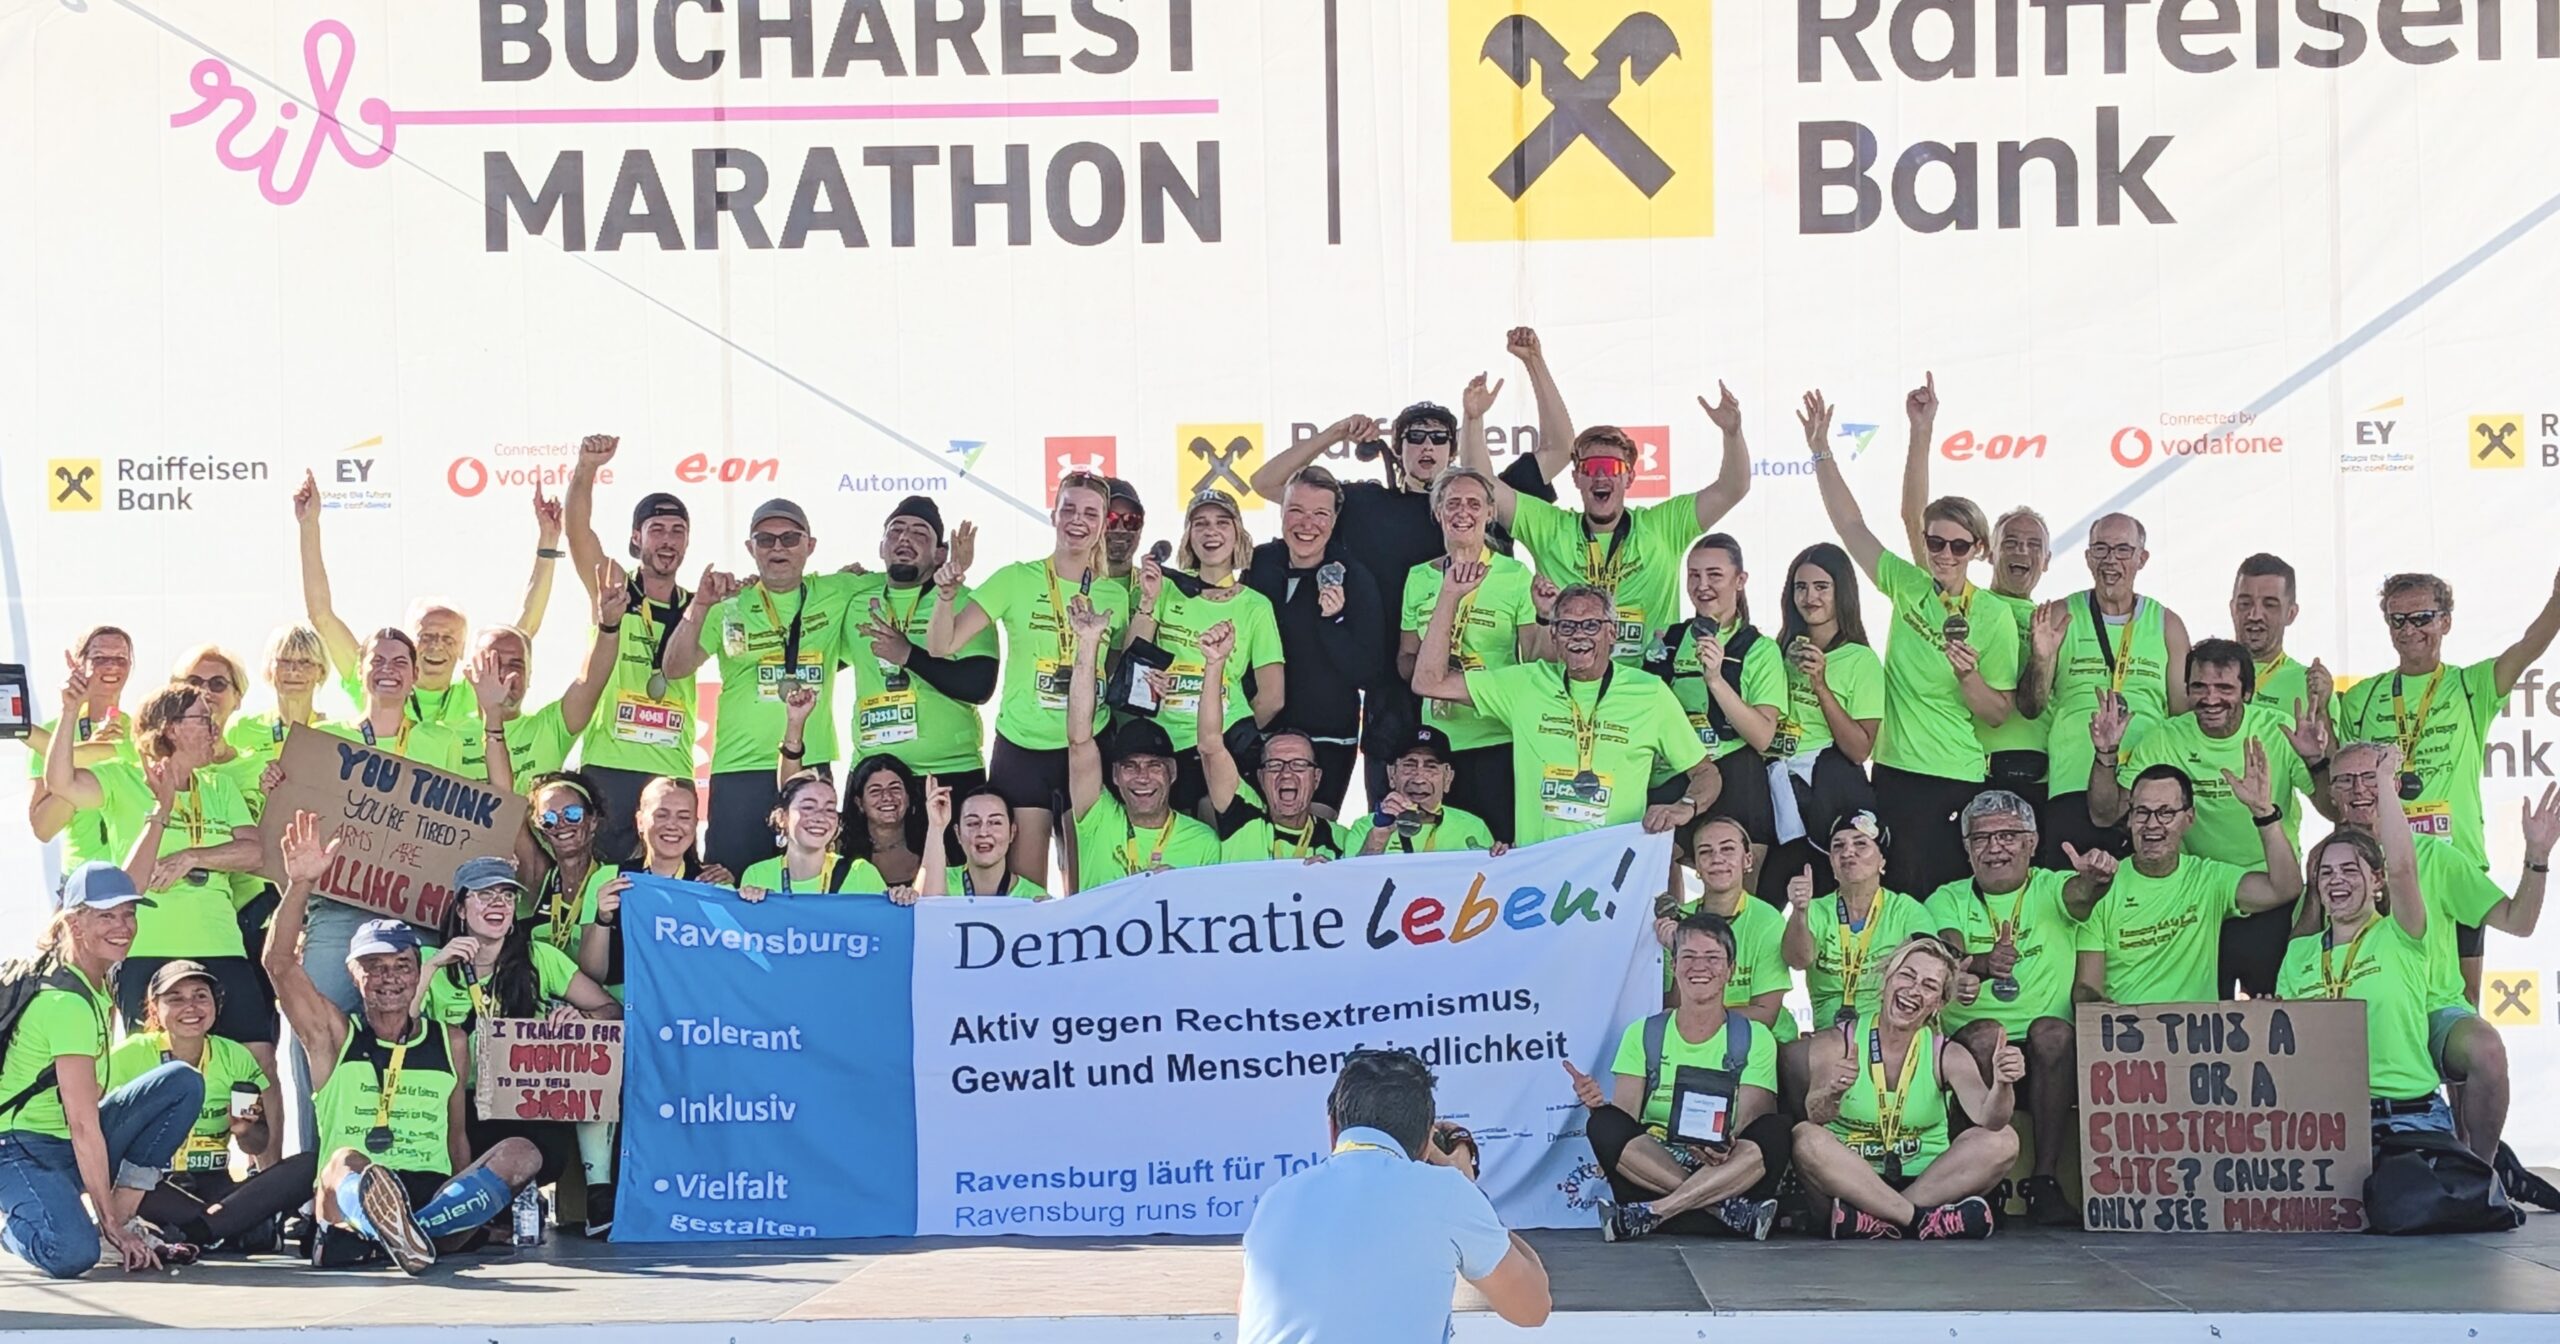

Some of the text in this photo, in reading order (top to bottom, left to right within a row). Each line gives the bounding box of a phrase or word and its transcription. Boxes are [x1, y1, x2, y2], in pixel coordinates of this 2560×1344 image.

[481, 0, 1200, 82] BUCHAREST
[1798, 106, 2178, 234] Bank
[483, 141, 1222, 252] MARATHON
[2160, 410, 2257, 427] Connected by
[2356, 420, 2396, 445] EY
[494, 444, 568, 456] Connected
[2161, 431, 2283, 457] vodafone
[118, 455, 268, 481] Raiffeisen
[336, 459, 375, 482] EY
[838, 474, 948, 492] Autonom
[118, 487, 193, 510] Bank
[337, 742, 401, 793] YOU
[410, 768, 502, 829] THINK
[344, 789, 410, 833] YOU'RE
[319, 855, 410, 915] ILLING
[655, 915, 880, 959] Ravensburg:
[954, 892, 1346, 970] Demokratie
[492, 1021, 506, 1038] I
[592, 1024, 622, 1043] FOR
[677, 1016, 803, 1051] Tolerant
[950, 986, 1540, 1046] Aktiv gegen Rechtsextremismus,
[2101, 1009, 2296, 1055] IS THIS A
[510, 1043, 612, 1076] MONTHS
[951, 1056, 1076, 1095] Gewalt
[1087, 1053, 1155, 1087] und
[497, 1077, 512, 1087] TO
[2090, 1060, 2277, 1107] RUN OR A
[680, 1093, 797, 1124] Inklusiv
[676, 1171, 789, 1200] Vielfalt
[955, 1165, 1138, 1195] Ravensburg
[1147, 1158, 1214, 1186] läuft
[1222, 1156, 1266, 1182] für
[2090, 1156, 2335, 1199] SITE? CAUSE I
[669, 1212, 817, 1238] gestalten
[955, 1201, 1125, 1229] Ravensburg
[1136, 1201, 1197, 1221] runs
[1206, 1195, 1244, 1218] for
[2087, 1196, 2364, 1232] ONLY SEE MACHINES
